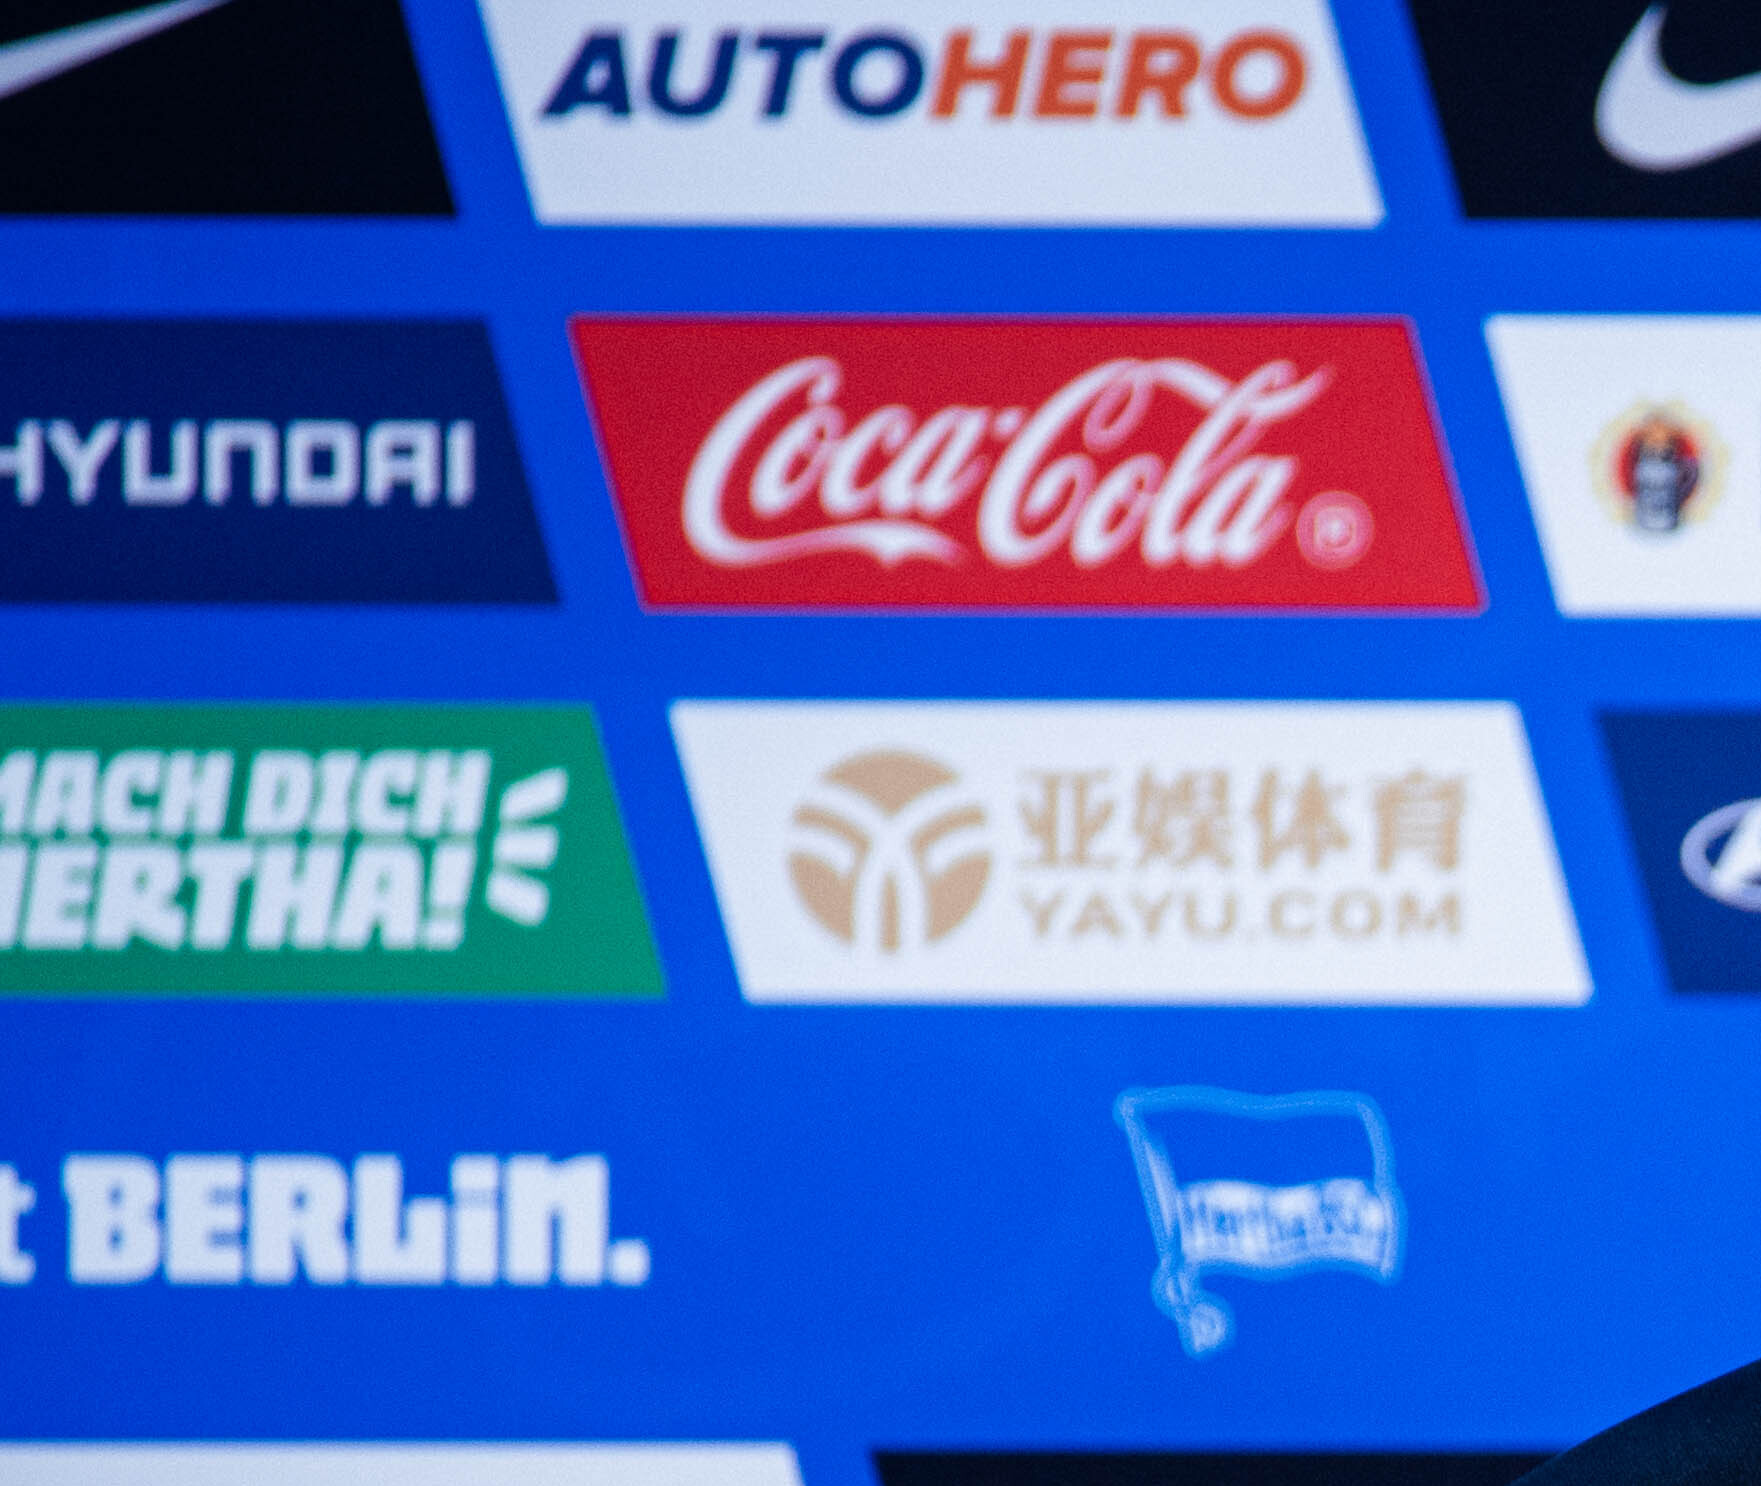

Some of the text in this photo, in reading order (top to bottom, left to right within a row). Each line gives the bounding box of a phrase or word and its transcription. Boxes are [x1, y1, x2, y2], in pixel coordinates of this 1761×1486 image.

[541, 30, 1306, 120] AUTOHERO
[243, 748, 493, 836] DICH
[1018, 766, 1470, 874] 亚娱体育
[0, 842, 478, 950] ERTHA!
[1018, 888, 1463, 942] YAYU.COM
